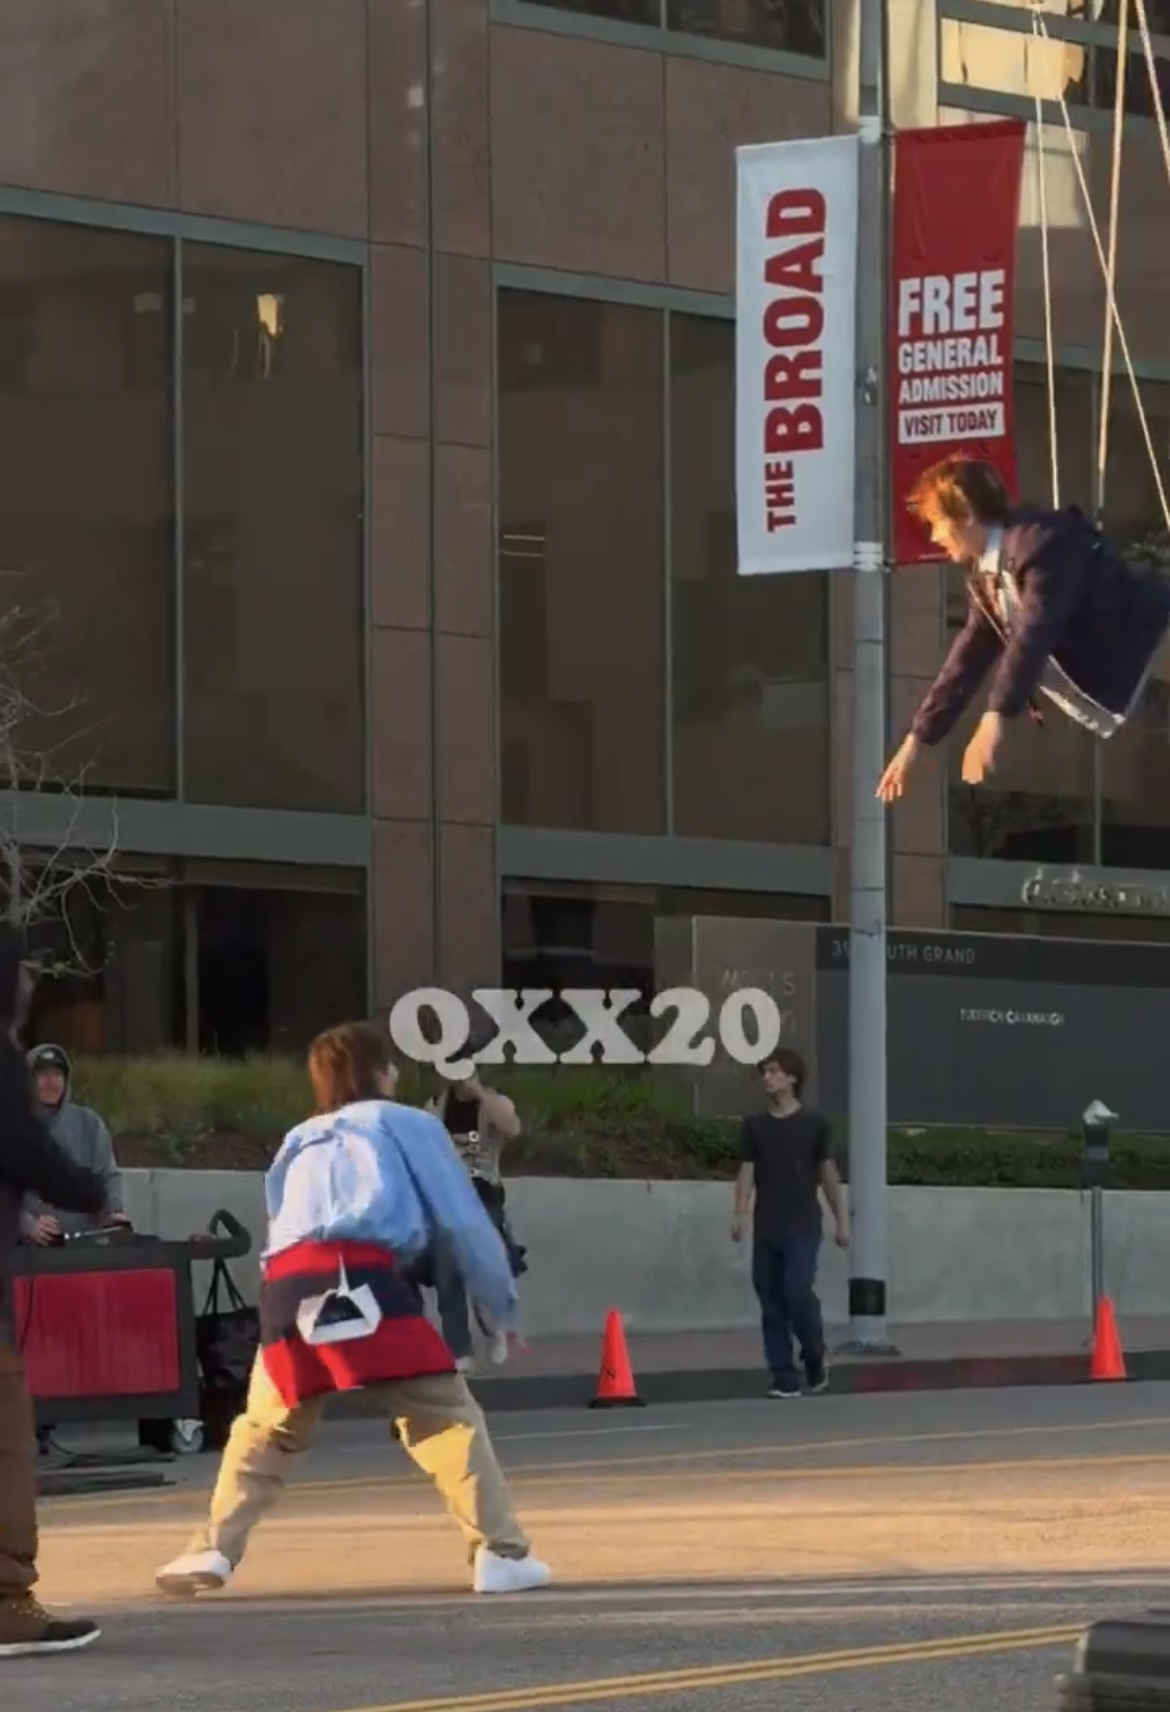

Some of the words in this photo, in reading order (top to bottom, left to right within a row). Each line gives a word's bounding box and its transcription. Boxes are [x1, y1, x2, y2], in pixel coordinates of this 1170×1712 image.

[763, 188, 825, 453] BROAD
[899, 270, 1005, 337] FREE
[899, 334, 1003, 374] GENERAL
[899, 371, 1003, 404] ADMISSION
[904, 413, 943, 437] VISIT
[947, 409, 997, 432] TODAY
[765, 460, 796, 532] THE
[922, 945, 976, 965] GRAND
